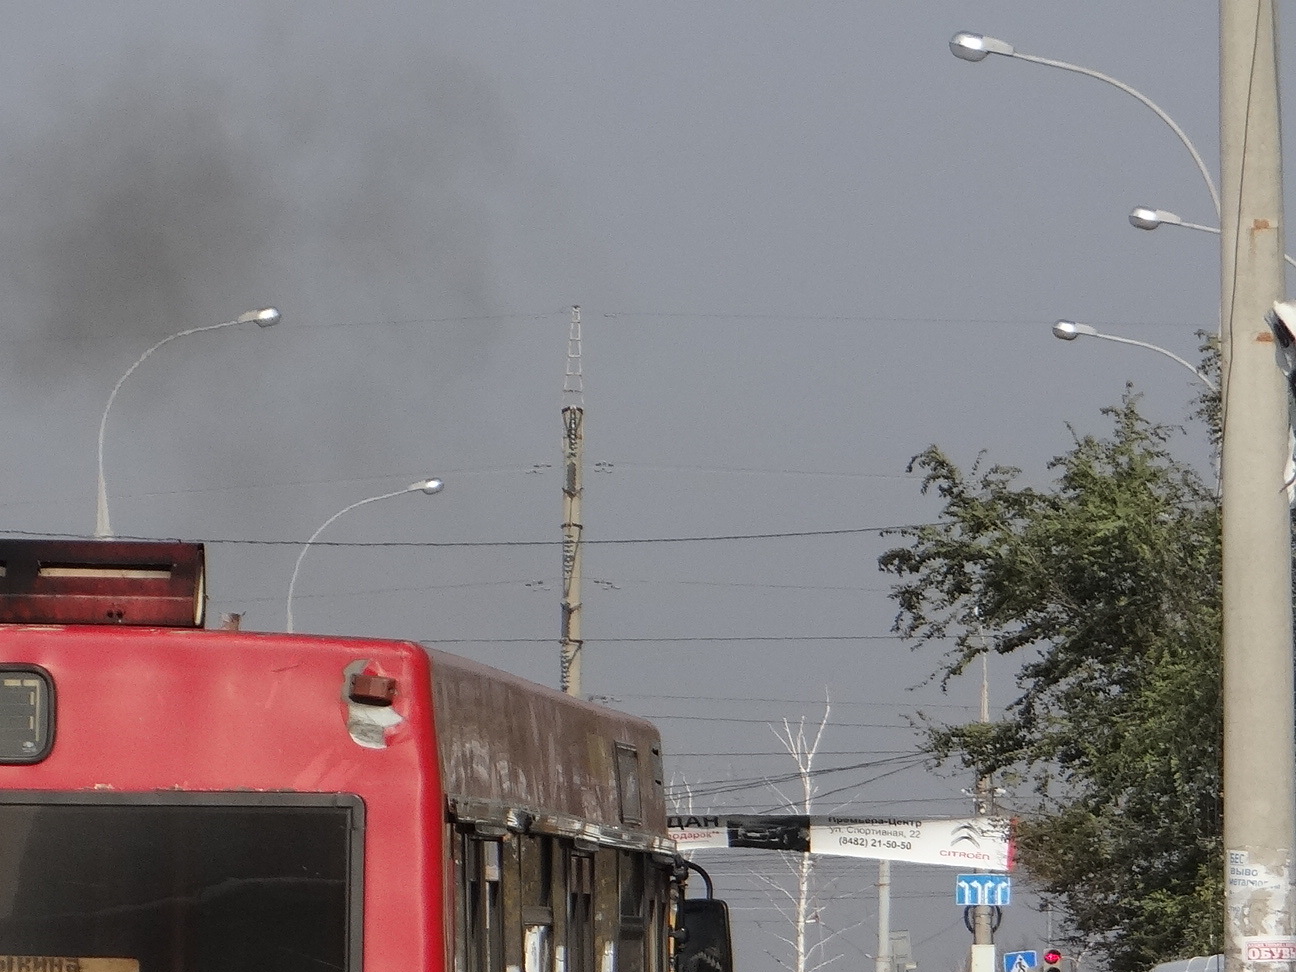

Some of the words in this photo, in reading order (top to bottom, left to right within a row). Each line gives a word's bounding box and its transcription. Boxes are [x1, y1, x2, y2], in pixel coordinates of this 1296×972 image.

[909, 830, 921, 838] 22
[839, 836, 868, 848] (8482)
[871, 838, 912, 850] 21-50-50
